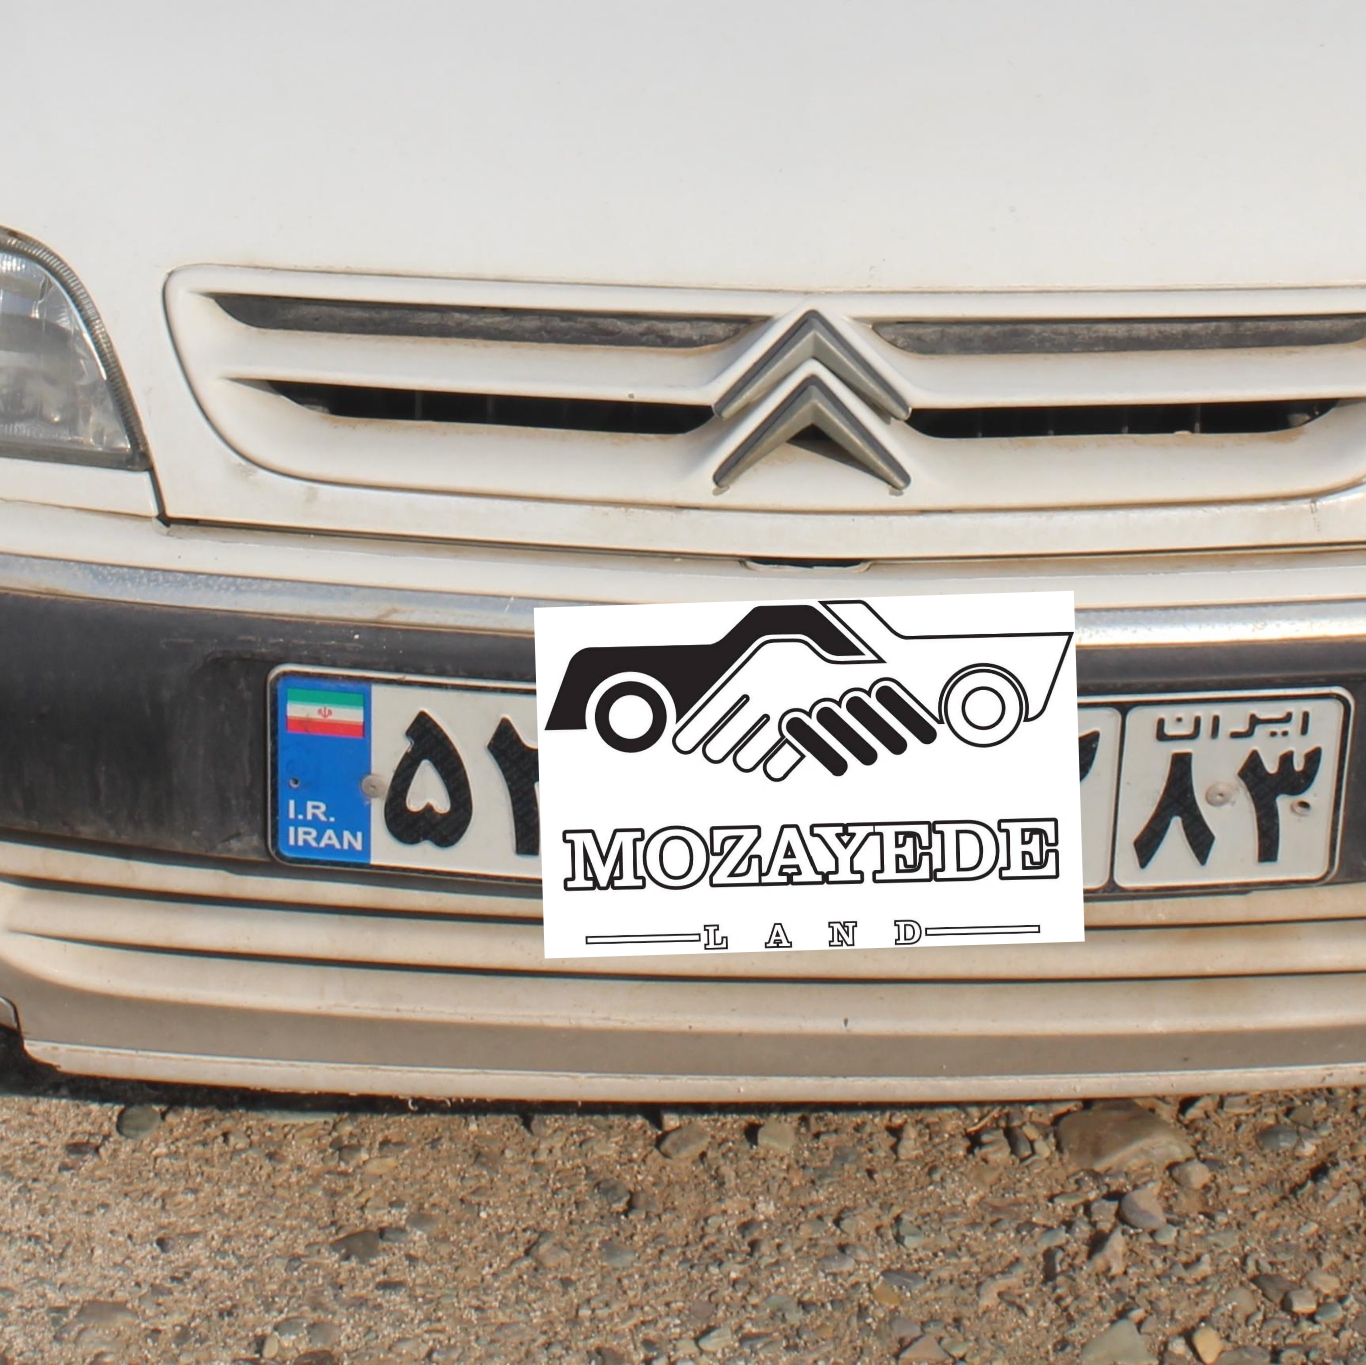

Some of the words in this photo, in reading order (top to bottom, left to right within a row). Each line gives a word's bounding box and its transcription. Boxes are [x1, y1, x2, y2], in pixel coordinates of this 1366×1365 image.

[1155, 710, 1311, 742] ایران
[287, 799, 336, 822] I.R.
[1133, 746, 1323, 870] ۸۳
[287, 825, 363, 851] IRAN
